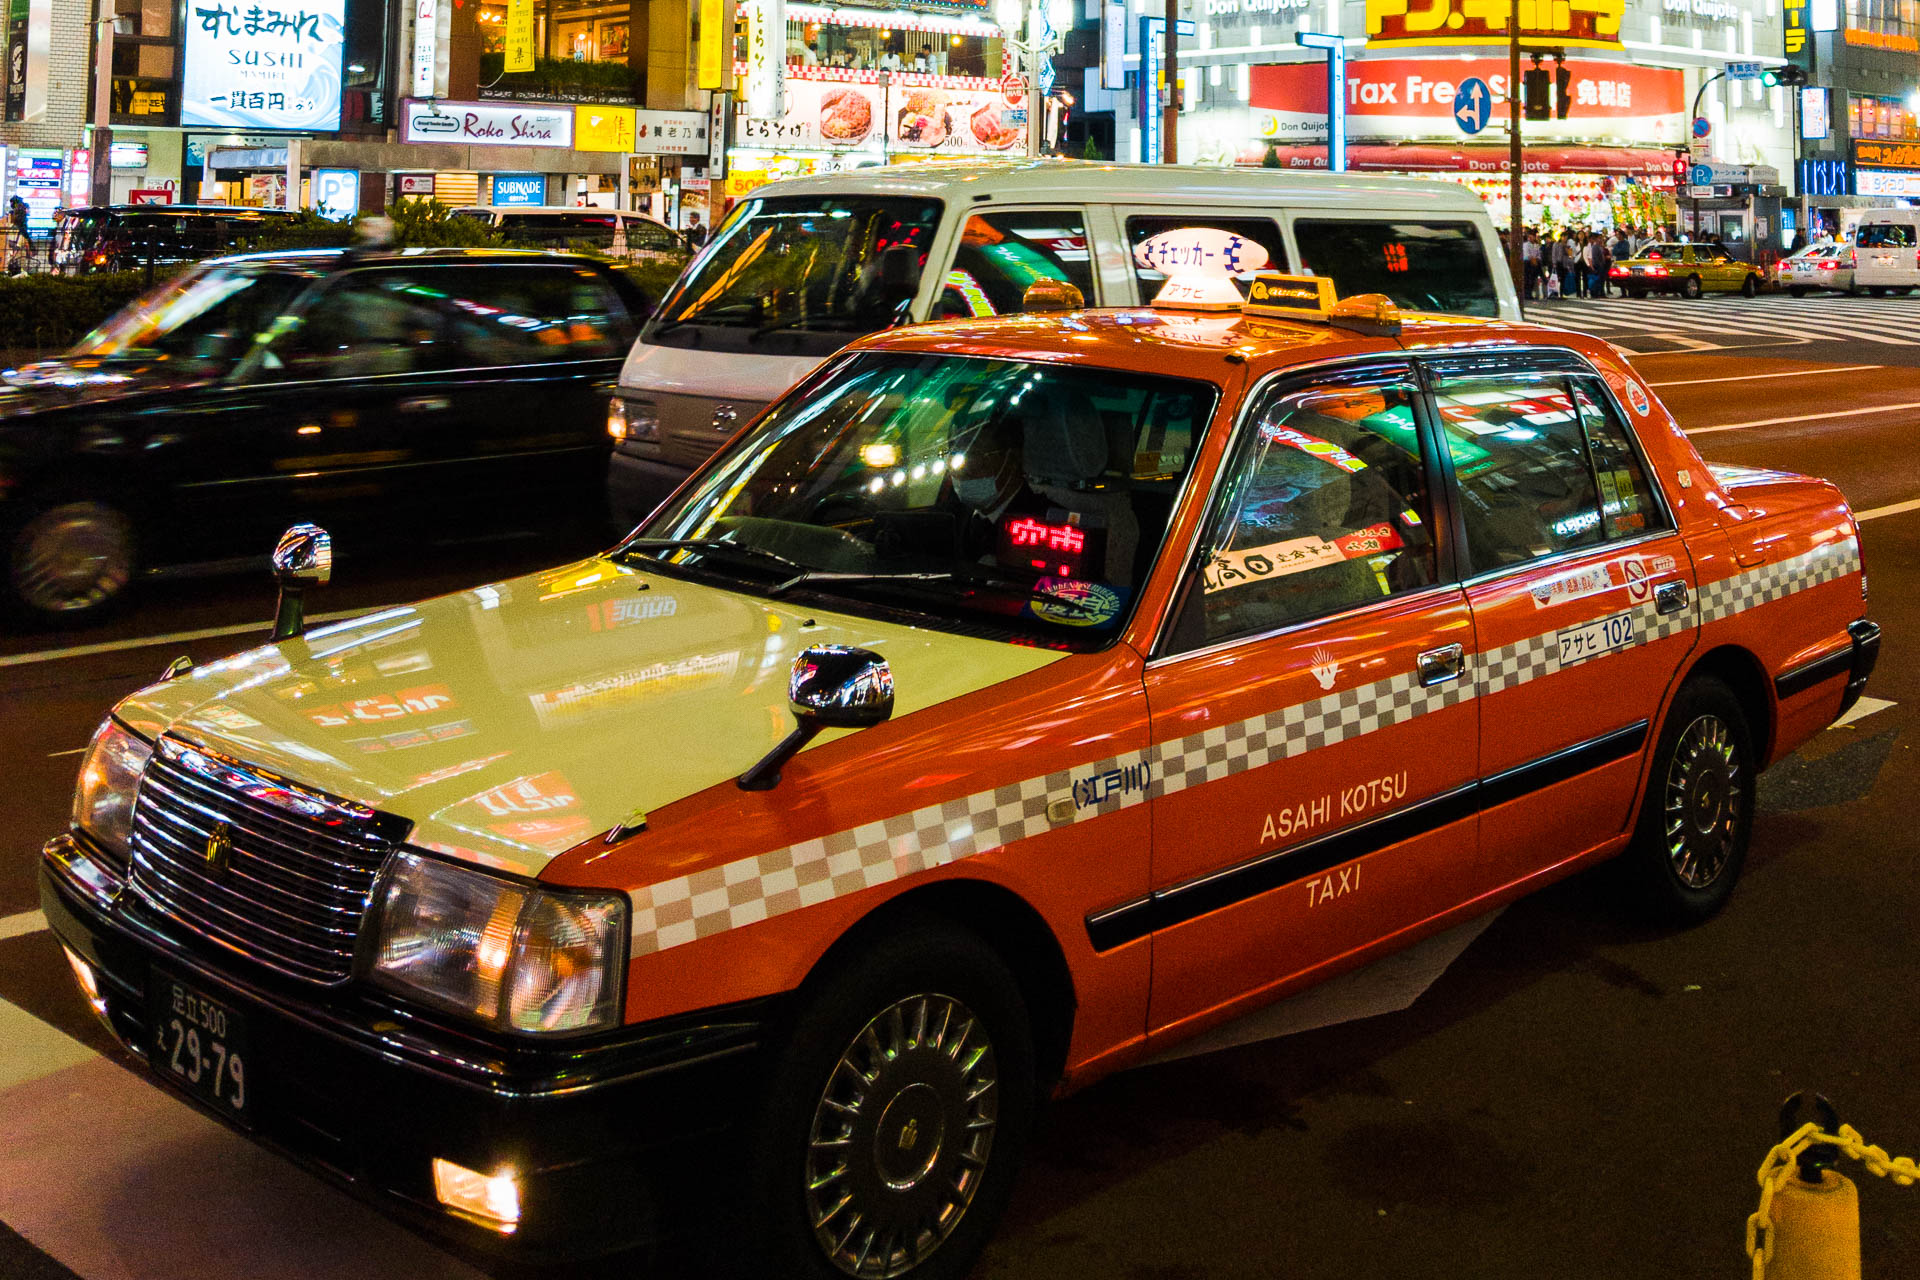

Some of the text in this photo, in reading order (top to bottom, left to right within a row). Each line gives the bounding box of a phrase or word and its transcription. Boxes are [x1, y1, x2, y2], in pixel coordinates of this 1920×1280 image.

[228, 49, 303, 68] SUSHI
[1347, 78, 1398, 105] Tax
[1406, 75, 1457, 104] Fre
[464, 112, 552, 140] Roko Shira
[1281, 121, 1329, 132] Don Quijot
[944, 136, 963, 147] 500
[1291, 157, 1310, 167] Don
[1469, 160, 1498, 171] Don
[498, 182, 541, 196] SUBNADE
[1168, 283, 1204, 299] アサヒ
[1560, 615, 1634, 660] アサヒ 102
[1259, 769, 1409, 845] ASAHI KOTSU
[1305, 863, 1362, 909] TAXI
[200, 1001, 226, 1038] 500
